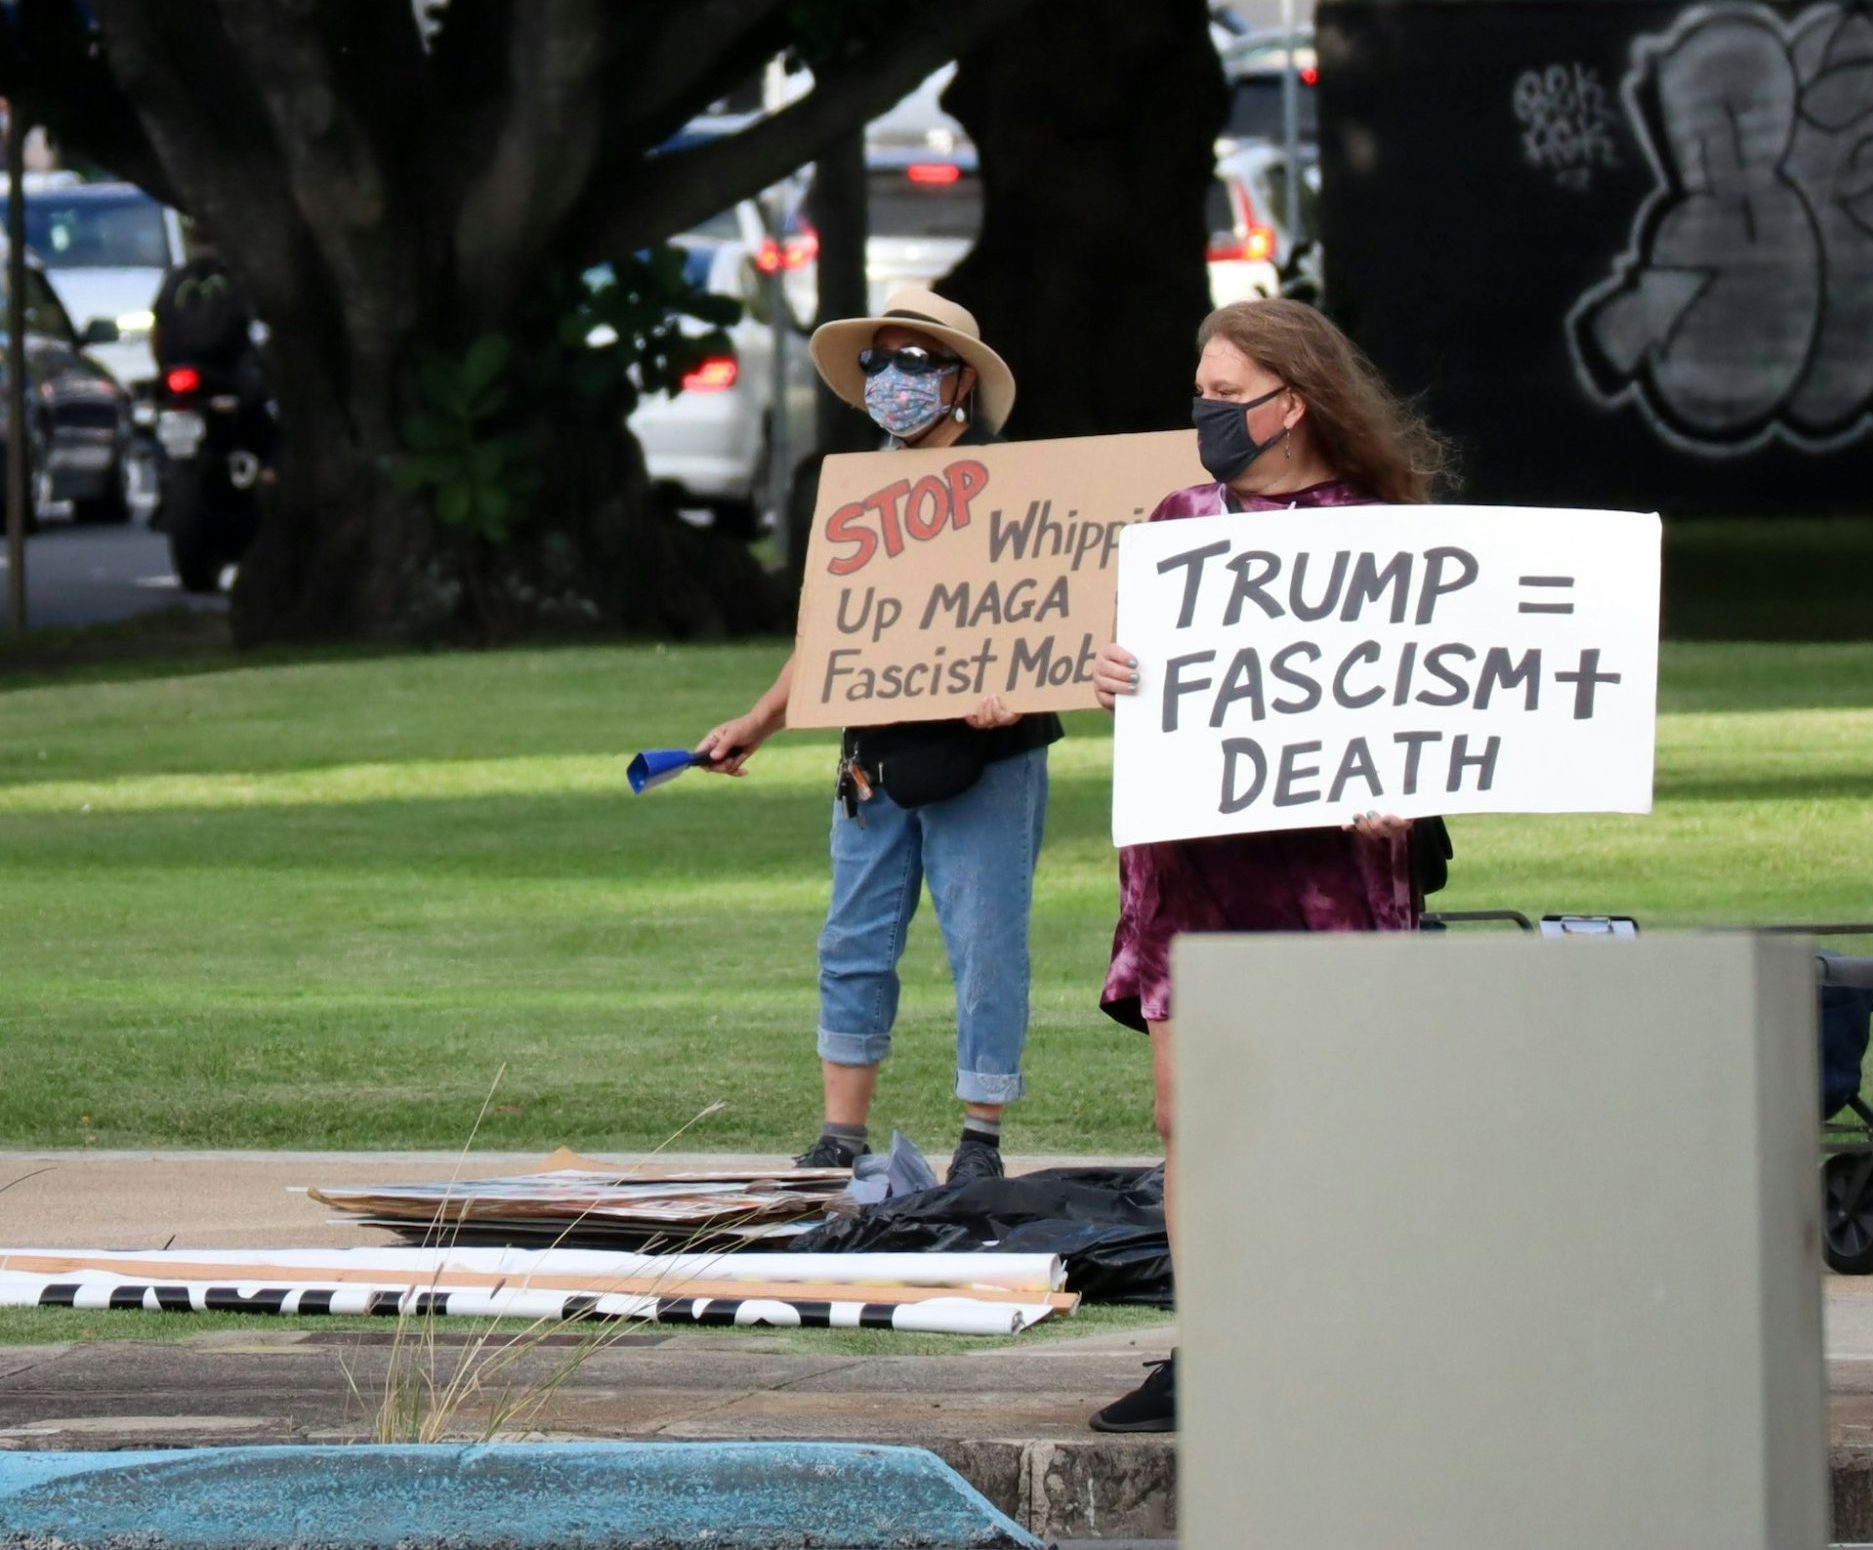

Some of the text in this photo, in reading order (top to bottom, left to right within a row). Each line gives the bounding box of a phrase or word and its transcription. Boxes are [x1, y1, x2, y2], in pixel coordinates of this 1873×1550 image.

[826, 460, 989, 575] STOP
[836, 575, 1070, 643] Up MAGA
[1156, 539, 1575, 629] TRUMP =
[821, 633, 1097, 704] Fascist Mob
[1218, 731, 1501, 815] DEATH
